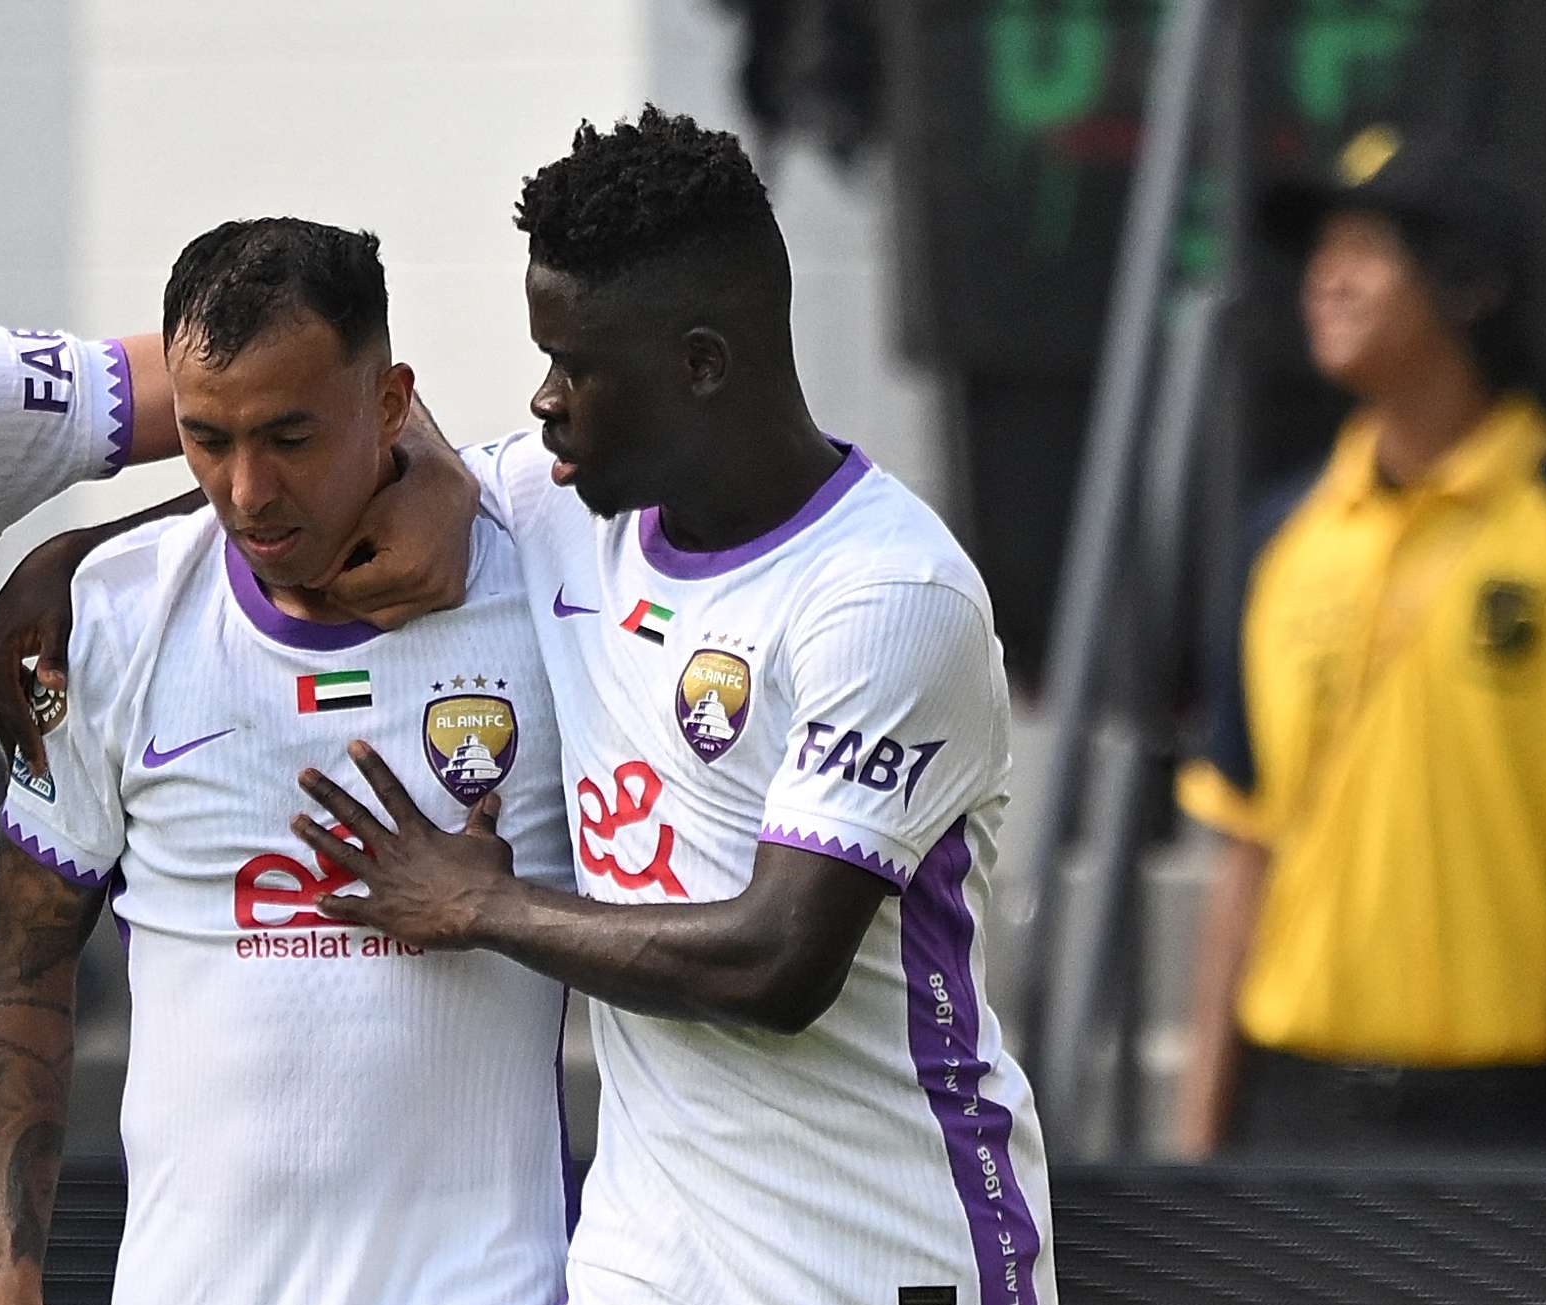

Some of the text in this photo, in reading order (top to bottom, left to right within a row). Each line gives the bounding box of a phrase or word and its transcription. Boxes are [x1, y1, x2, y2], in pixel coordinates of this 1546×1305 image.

[10, 329, 73, 414] FA
[727, 674, 743, 689] FC
[436, 714, 505, 729] AL AIN FC
[236, 931, 352, 959] etisalat
[928, 972, 954, 1027] 1968
[976, 1145, 1003, 1201] 1968
[998, 1231, 1016, 1257] FC
[1005, 1261, 1019, 1293] AIN
